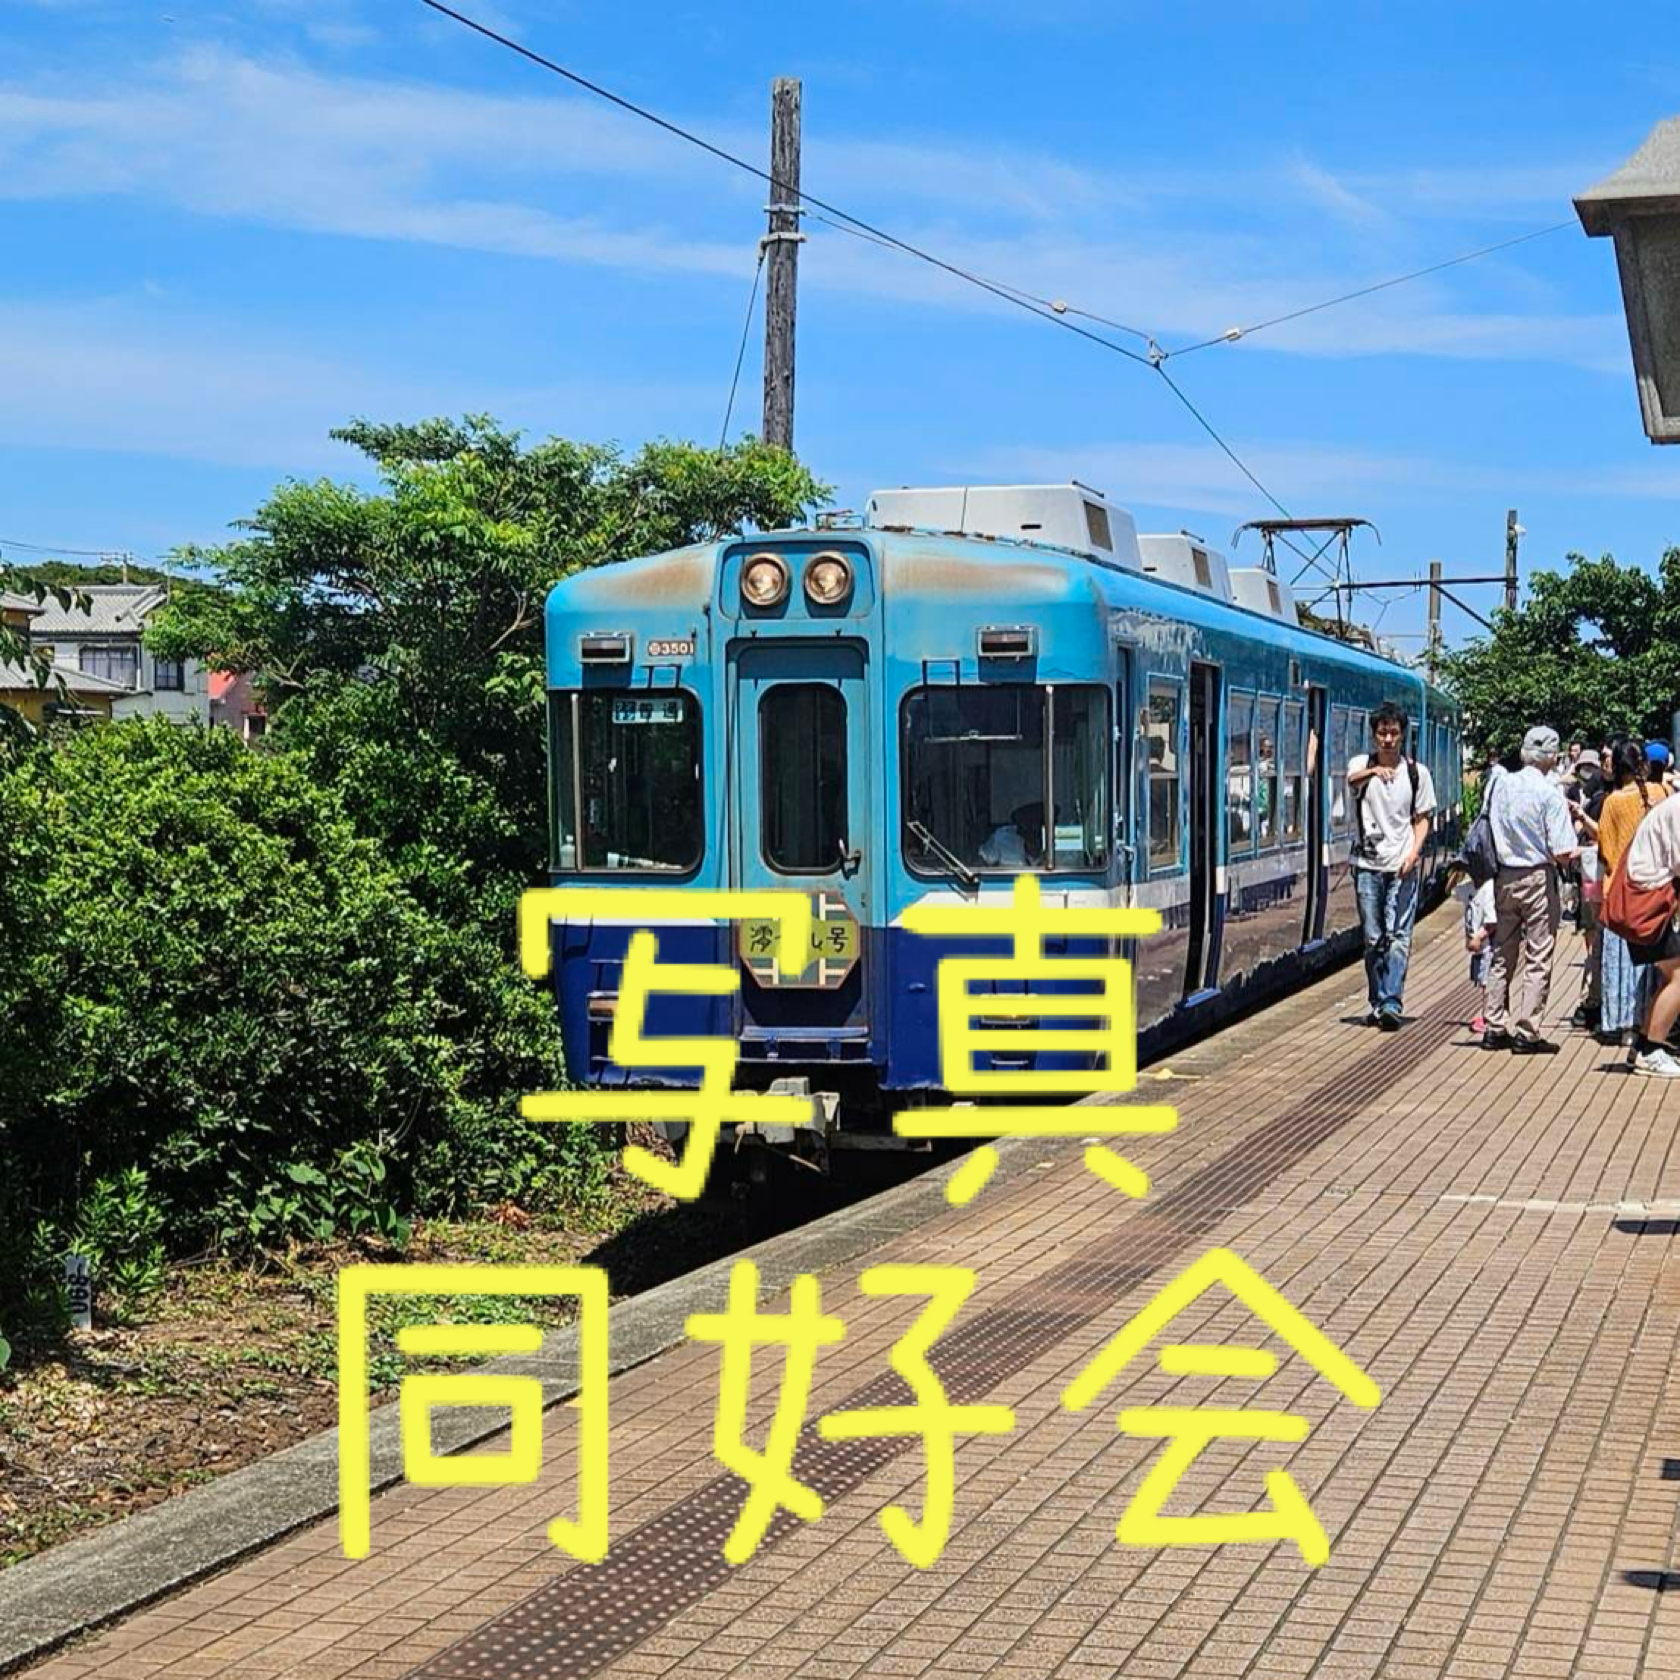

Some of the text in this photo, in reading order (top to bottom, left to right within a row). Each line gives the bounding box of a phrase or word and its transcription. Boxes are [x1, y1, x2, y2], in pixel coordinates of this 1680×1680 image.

[662, 642, 694, 655] 3501
[750, 925, 849, 953] 澪し号
